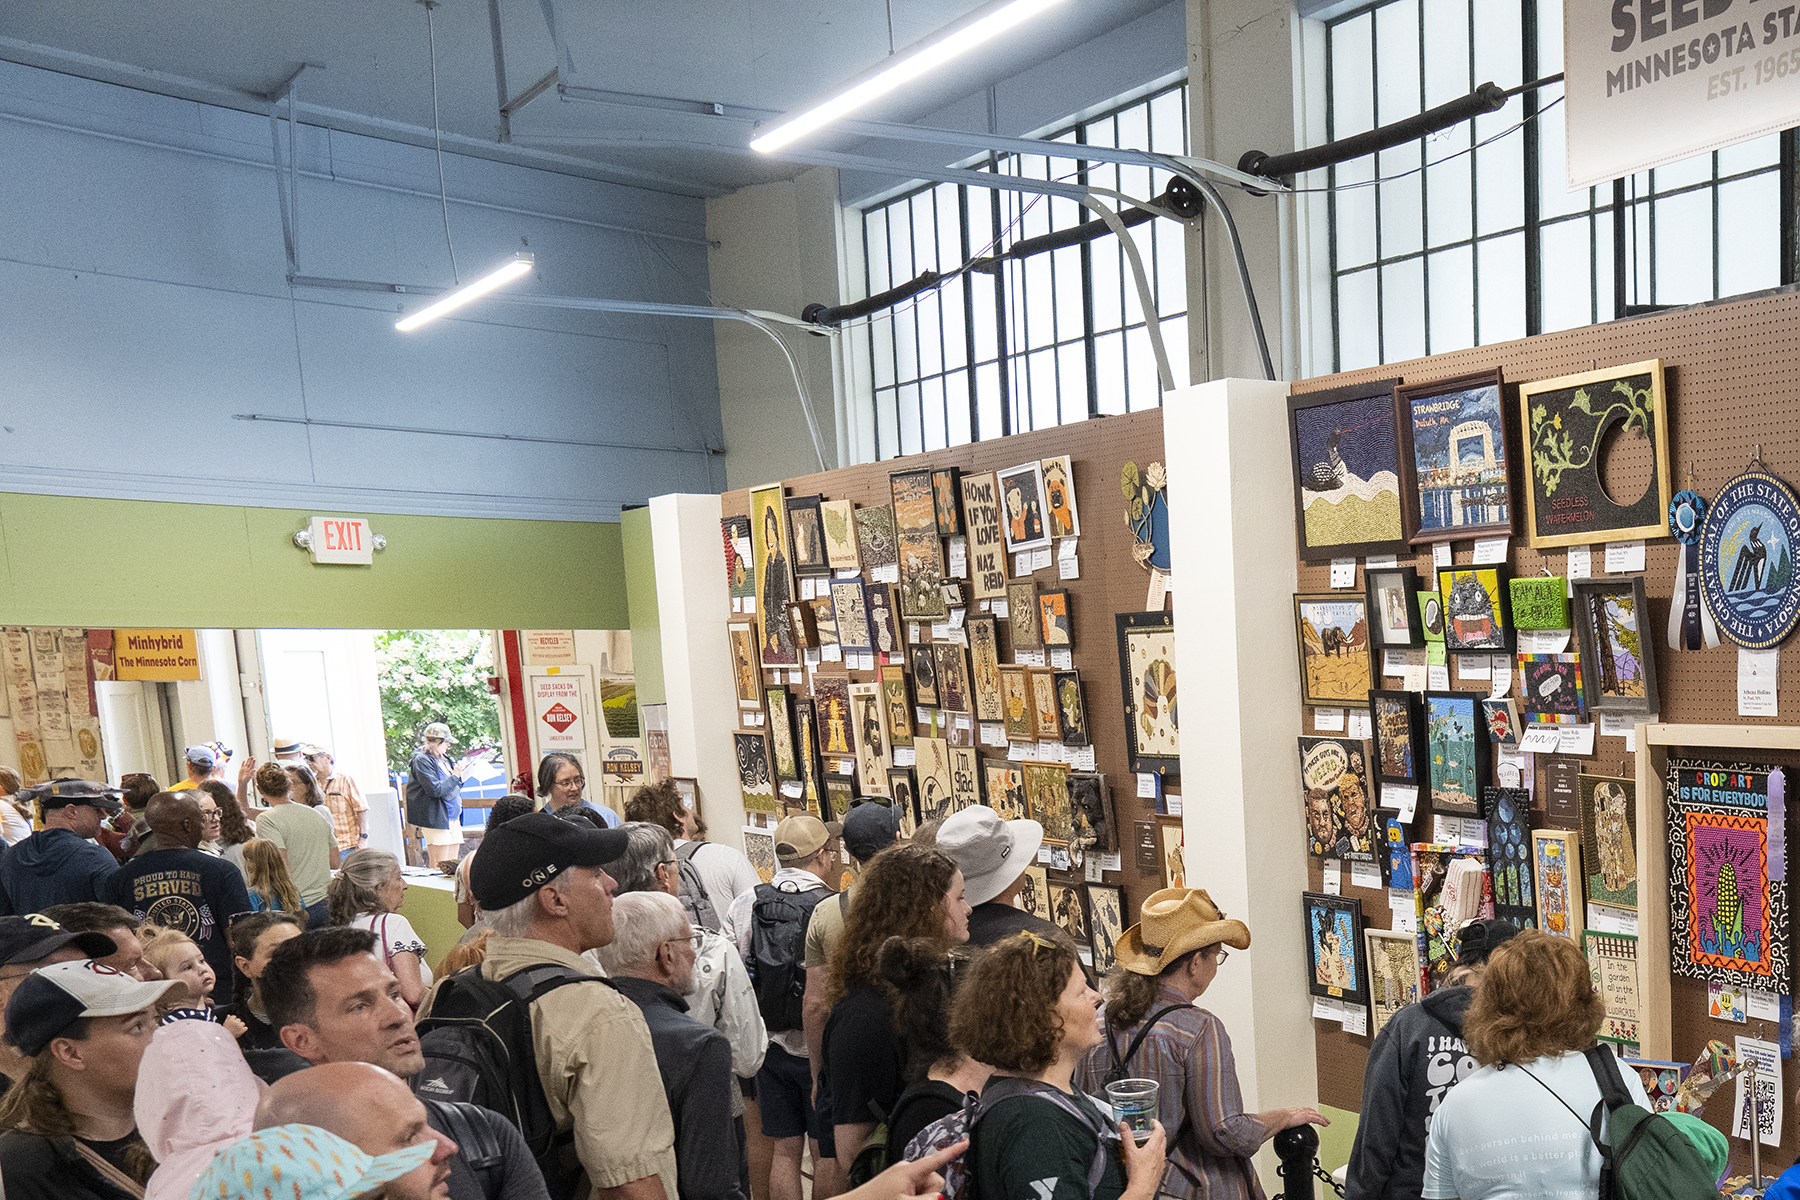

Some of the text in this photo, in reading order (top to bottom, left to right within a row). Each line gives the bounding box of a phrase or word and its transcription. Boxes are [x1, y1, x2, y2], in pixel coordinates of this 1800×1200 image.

[1606, 21, 1756, 98] MINNESOTA
[1707, 65, 1748, 101] EST.
[1413, 400, 1460, 416] STRAWBRIDGE
[963, 481, 993, 503] HONK
[1730, 483, 1755, 502] THE
[1757, 484, 1793, 518] STATE
[1551, 496, 1589, 510] SEEDLESS
[1716, 497, 1731, 519] OF
[968, 505, 998, 527] IF YOU
[1546, 510, 1595, 524] WATERMELON
[323, 520, 362, 551] EXIT
[976, 525, 1000, 546] LOVE
[1705, 522, 1719, 564] SEAL
[976, 553, 996, 573] NAZ
[983, 571, 1004, 592] REID
[1705, 570, 1730, 620] GREAT
[1730, 621, 1754, 638] THE
[127, 635, 184, 651] Minhybrid
[119, 655, 197, 667] The Minnesota Corn
[546, 713, 573, 723] RON KELSEY
[606, 762, 642, 773] RON KELSEY
[954, 771, 974, 793] glad
[1696, 771, 1753, 789] CROP ART
[1680, 787, 1768, 809] IS FOR EVERYBODY
[133, 870, 200, 886] PROUD TO HAVE
[522, 864, 558, 888] ONE
[133, 879, 202, 902] SERVED
[1607, 960, 1628, 971] In the
[1608, 972, 1631, 983] garden
